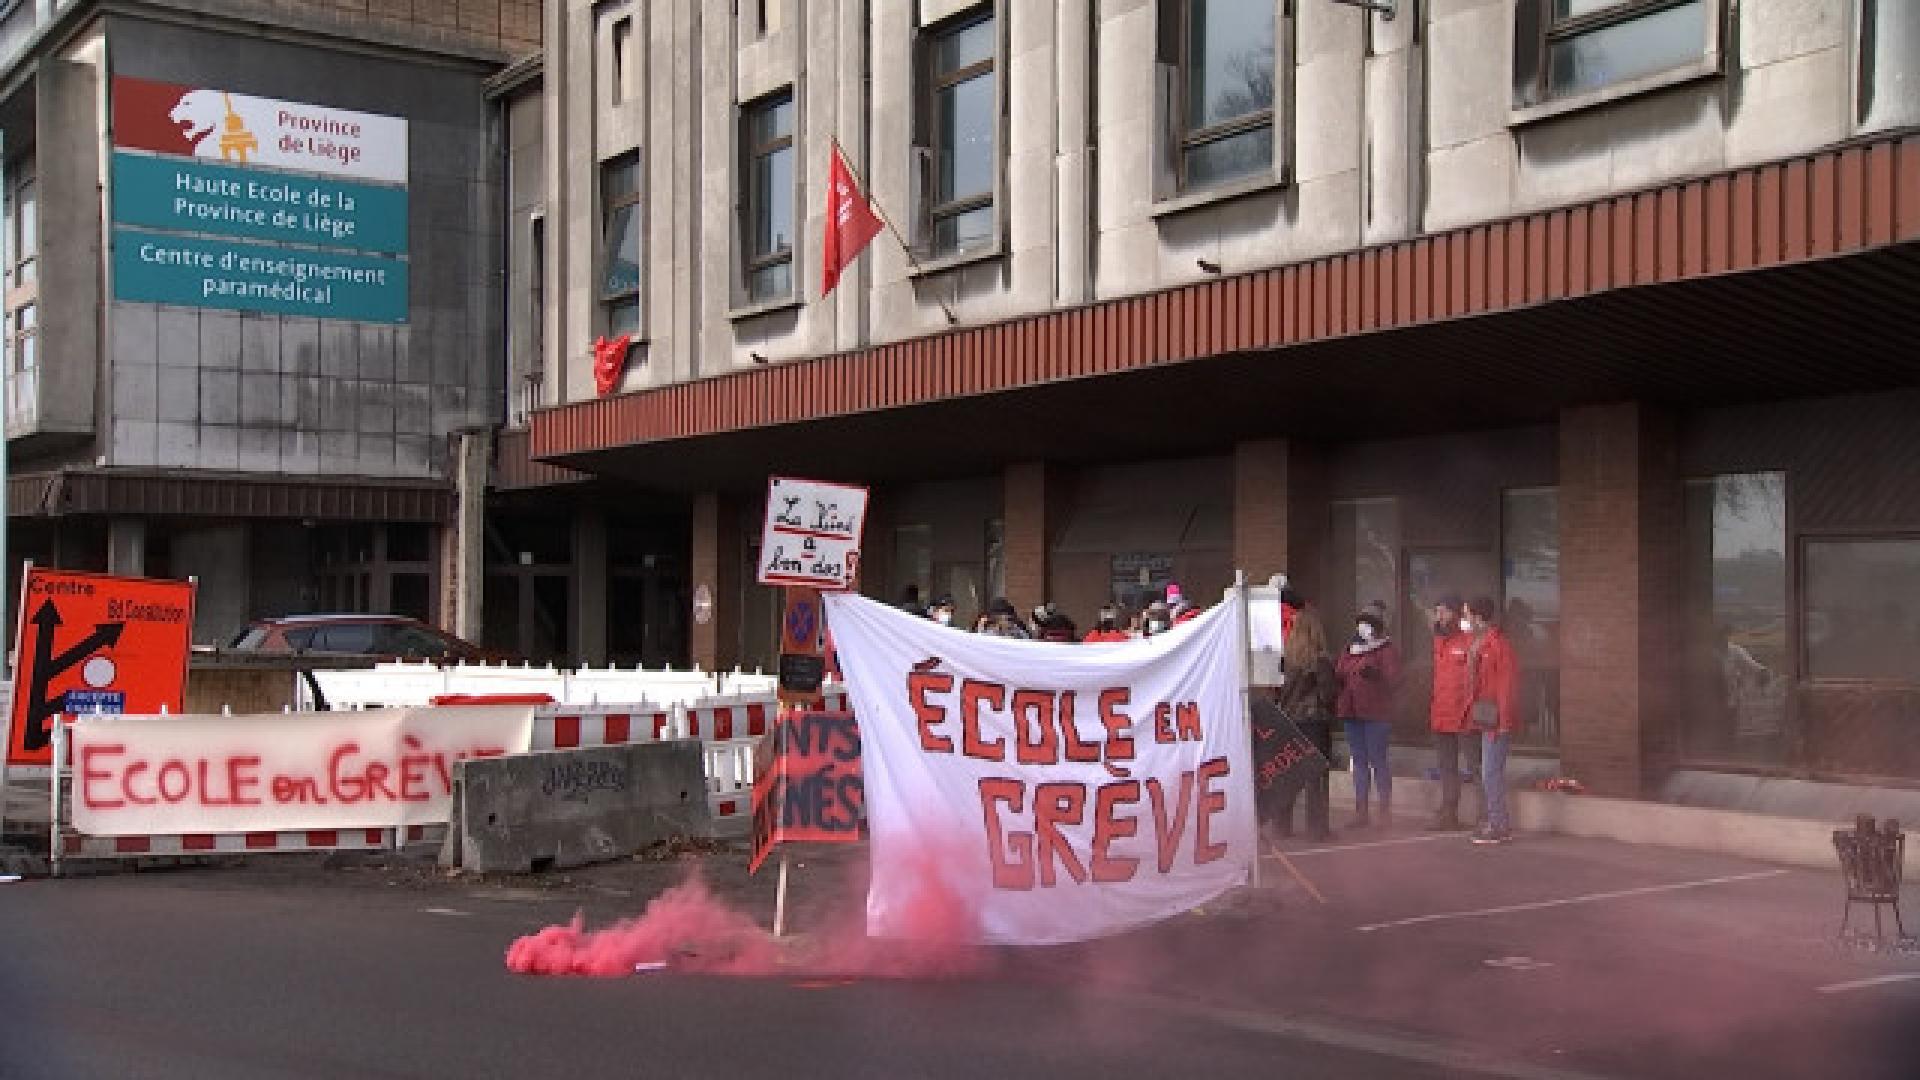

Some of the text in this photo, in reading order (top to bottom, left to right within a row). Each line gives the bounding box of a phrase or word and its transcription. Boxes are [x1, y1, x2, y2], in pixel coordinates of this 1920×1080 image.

[278, 110, 361, 138] Province
[278, 134, 361, 166] de Liège
[176, 172, 355, 212] Haute Ecole de la
[174, 198, 355, 239] Province de Liège
[140, 242, 385, 286] Centre d'enseignement
[203, 277, 331, 304] paramédical
[30, 575, 96, 597] Centre
[107, 598, 125, 619] Bd
[907, 656, 1135, 765] ÉCOLE
[978, 755, 1231, 892] GRÈVE
